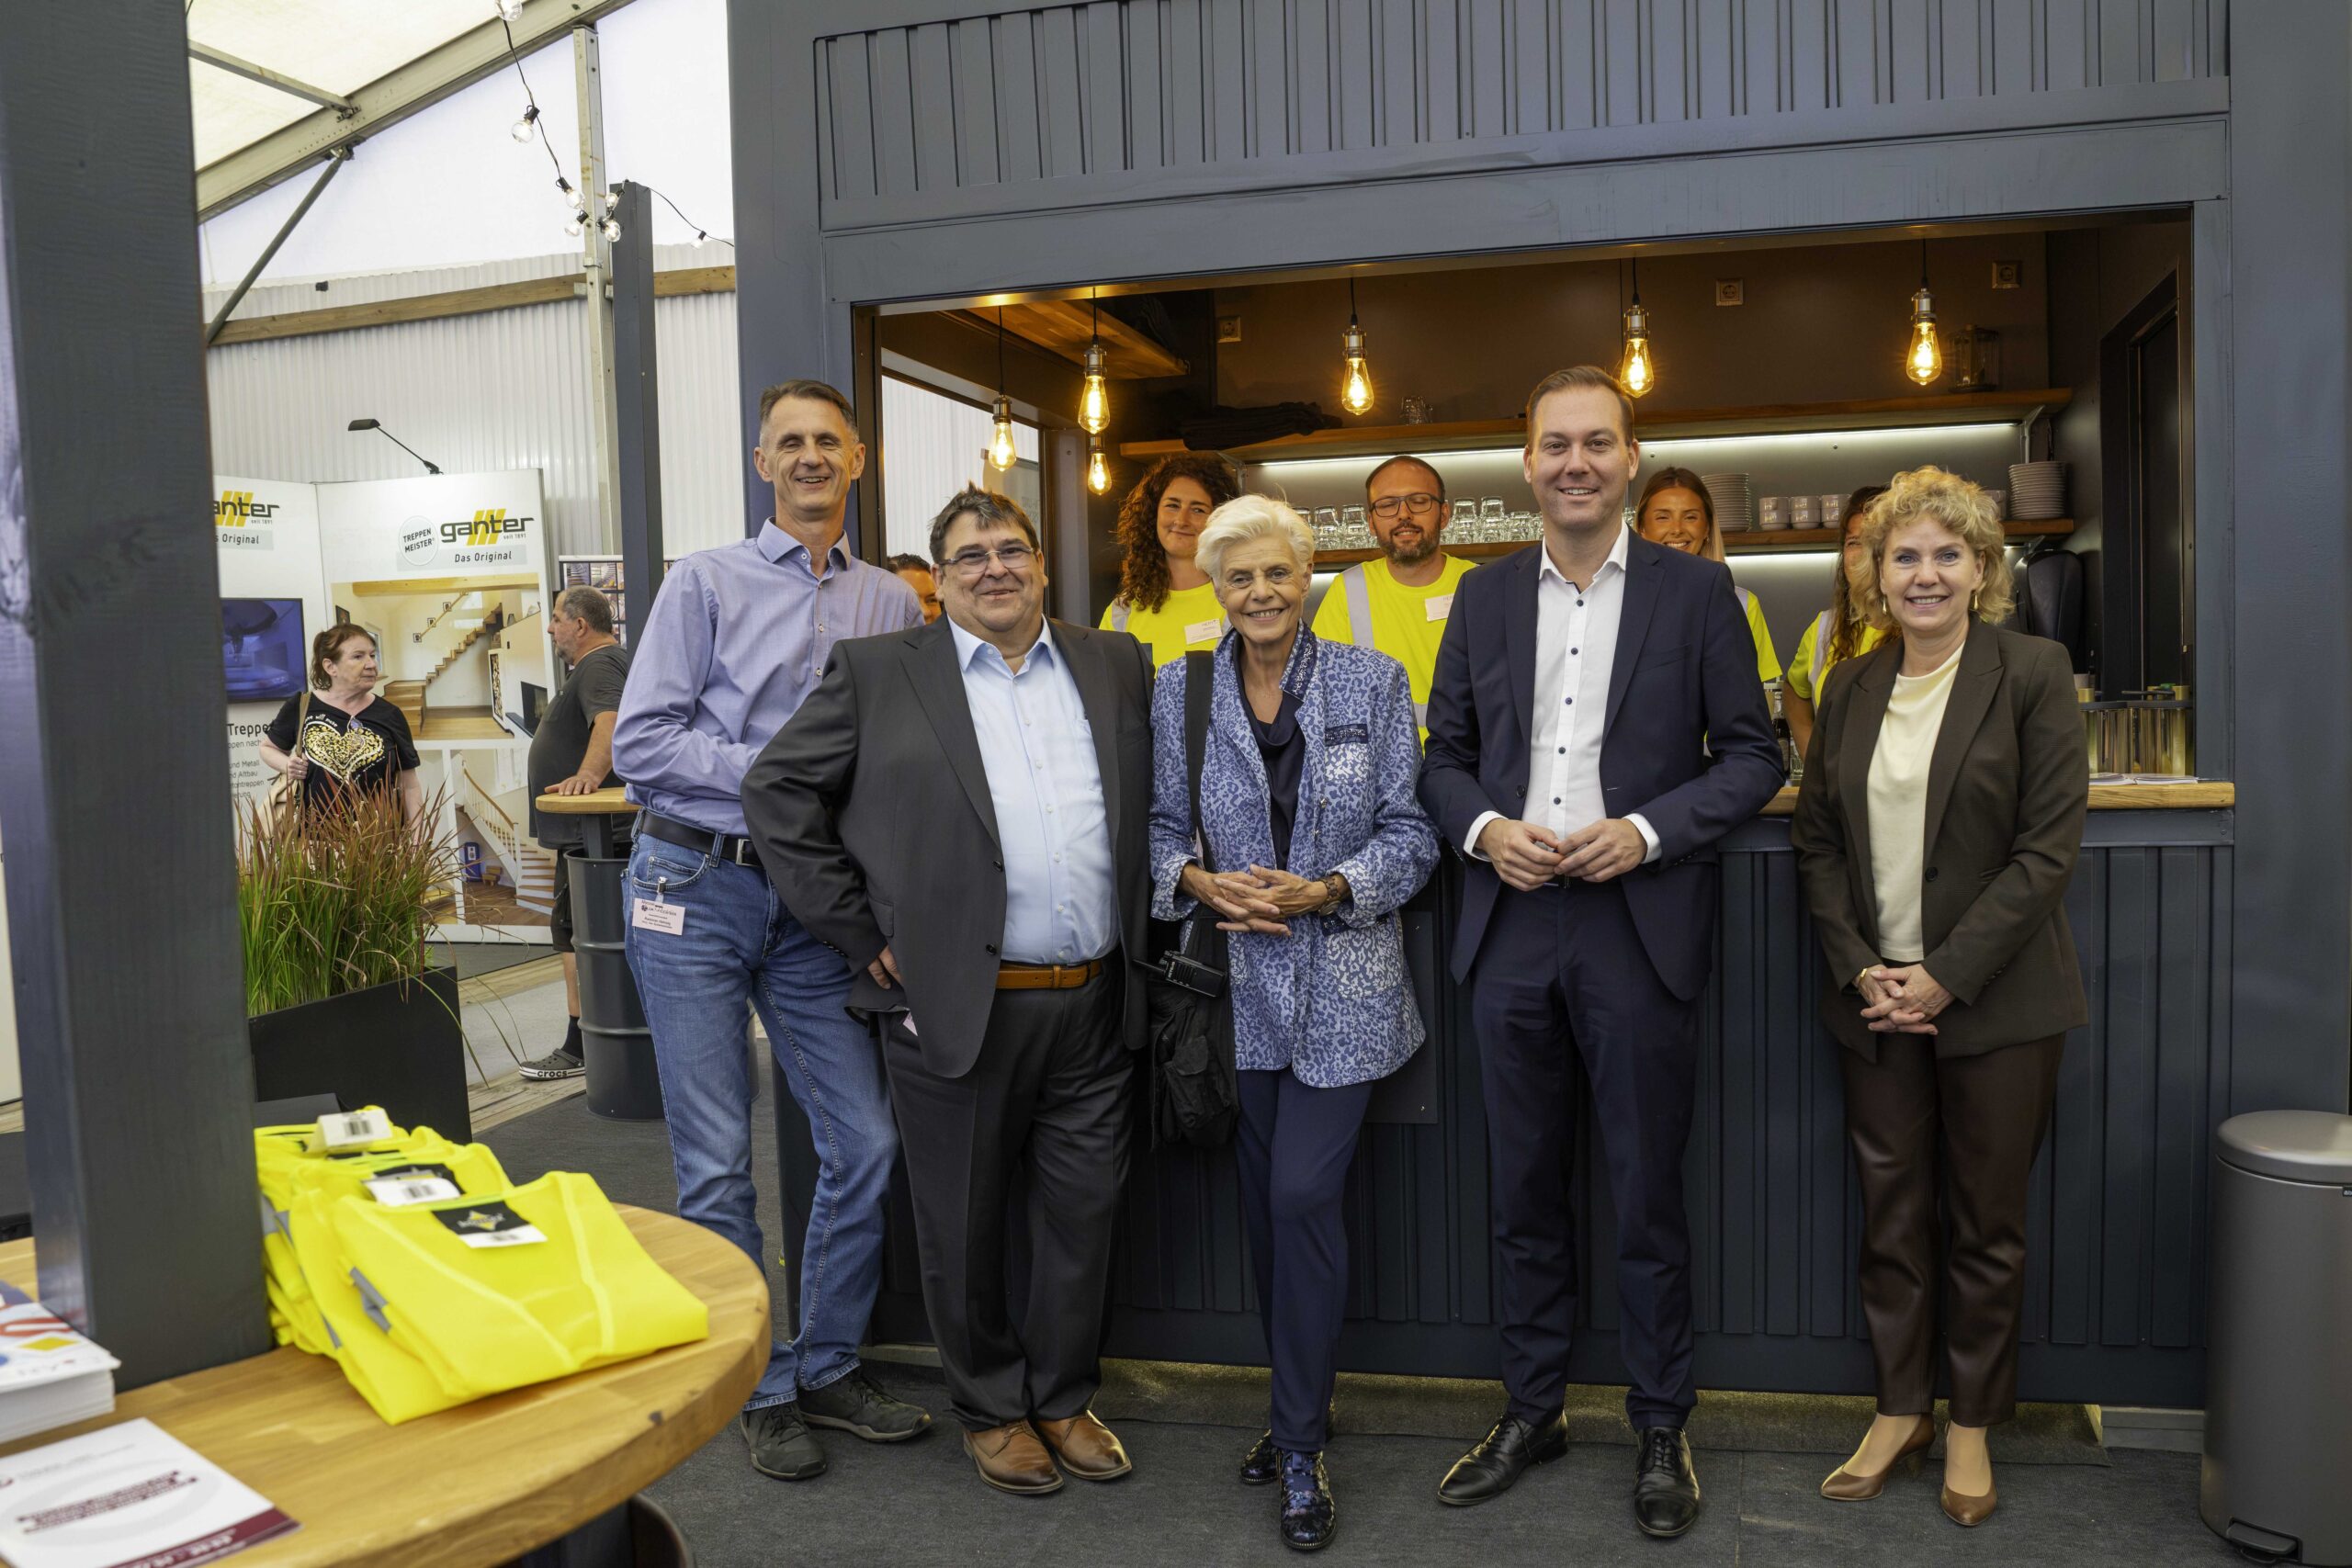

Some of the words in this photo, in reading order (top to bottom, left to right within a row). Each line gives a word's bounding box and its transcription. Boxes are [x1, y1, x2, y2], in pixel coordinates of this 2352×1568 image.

[403, 527, 432, 543] TREPPEN
[440, 514, 535, 543] ganter
[221, 533, 259, 546] Original
[454, 554, 471, 563] Das
[474, 551, 512, 563] Original
